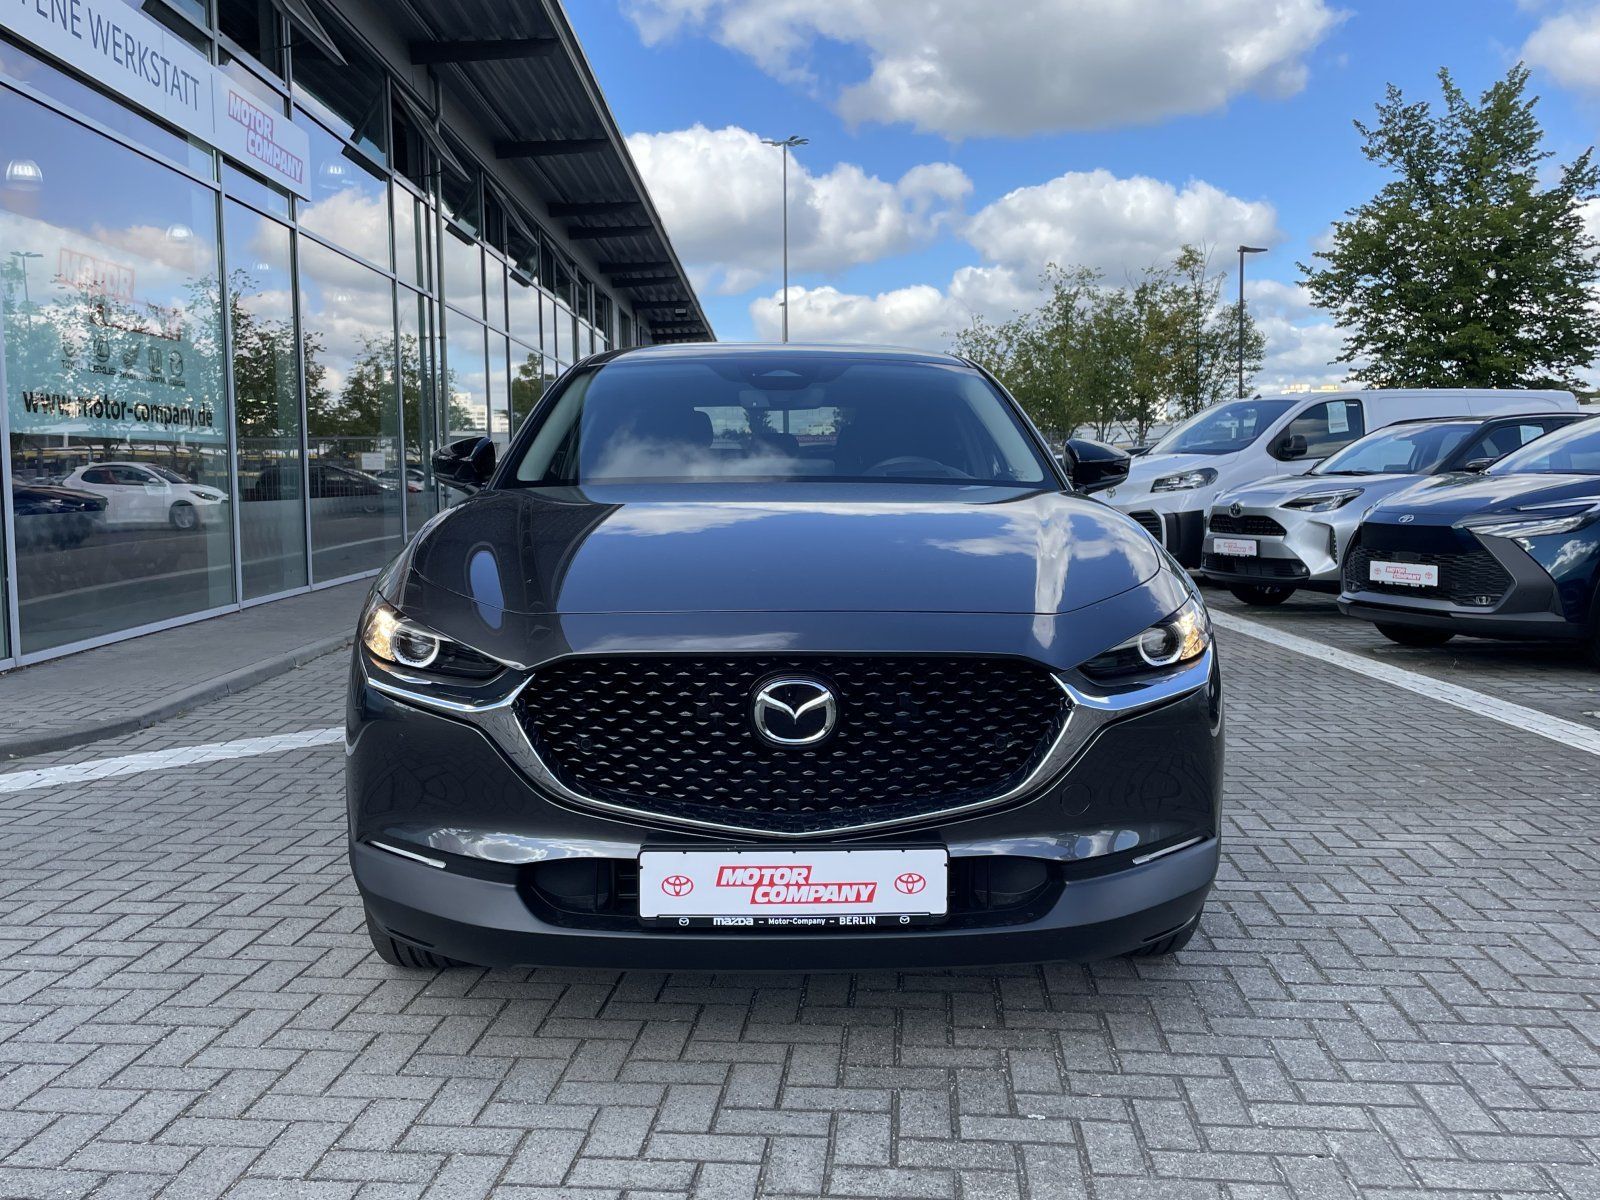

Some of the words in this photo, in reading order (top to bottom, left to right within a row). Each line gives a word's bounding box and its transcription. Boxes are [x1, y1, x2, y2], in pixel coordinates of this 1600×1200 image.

[88, 8, 200, 111] WERKSTATT
[229, 91, 273, 141] MOTOR
[248, 130, 303, 184] COMPANY
[22, 391, 213, 428] wwwmotor-company.de
[719, 867, 808, 885] MOTOR
[754, 884, 875, 903] COMPANY
[768, 917, 826, 926] Motor-Company
[839, 916, 876, 925] BERLIN
